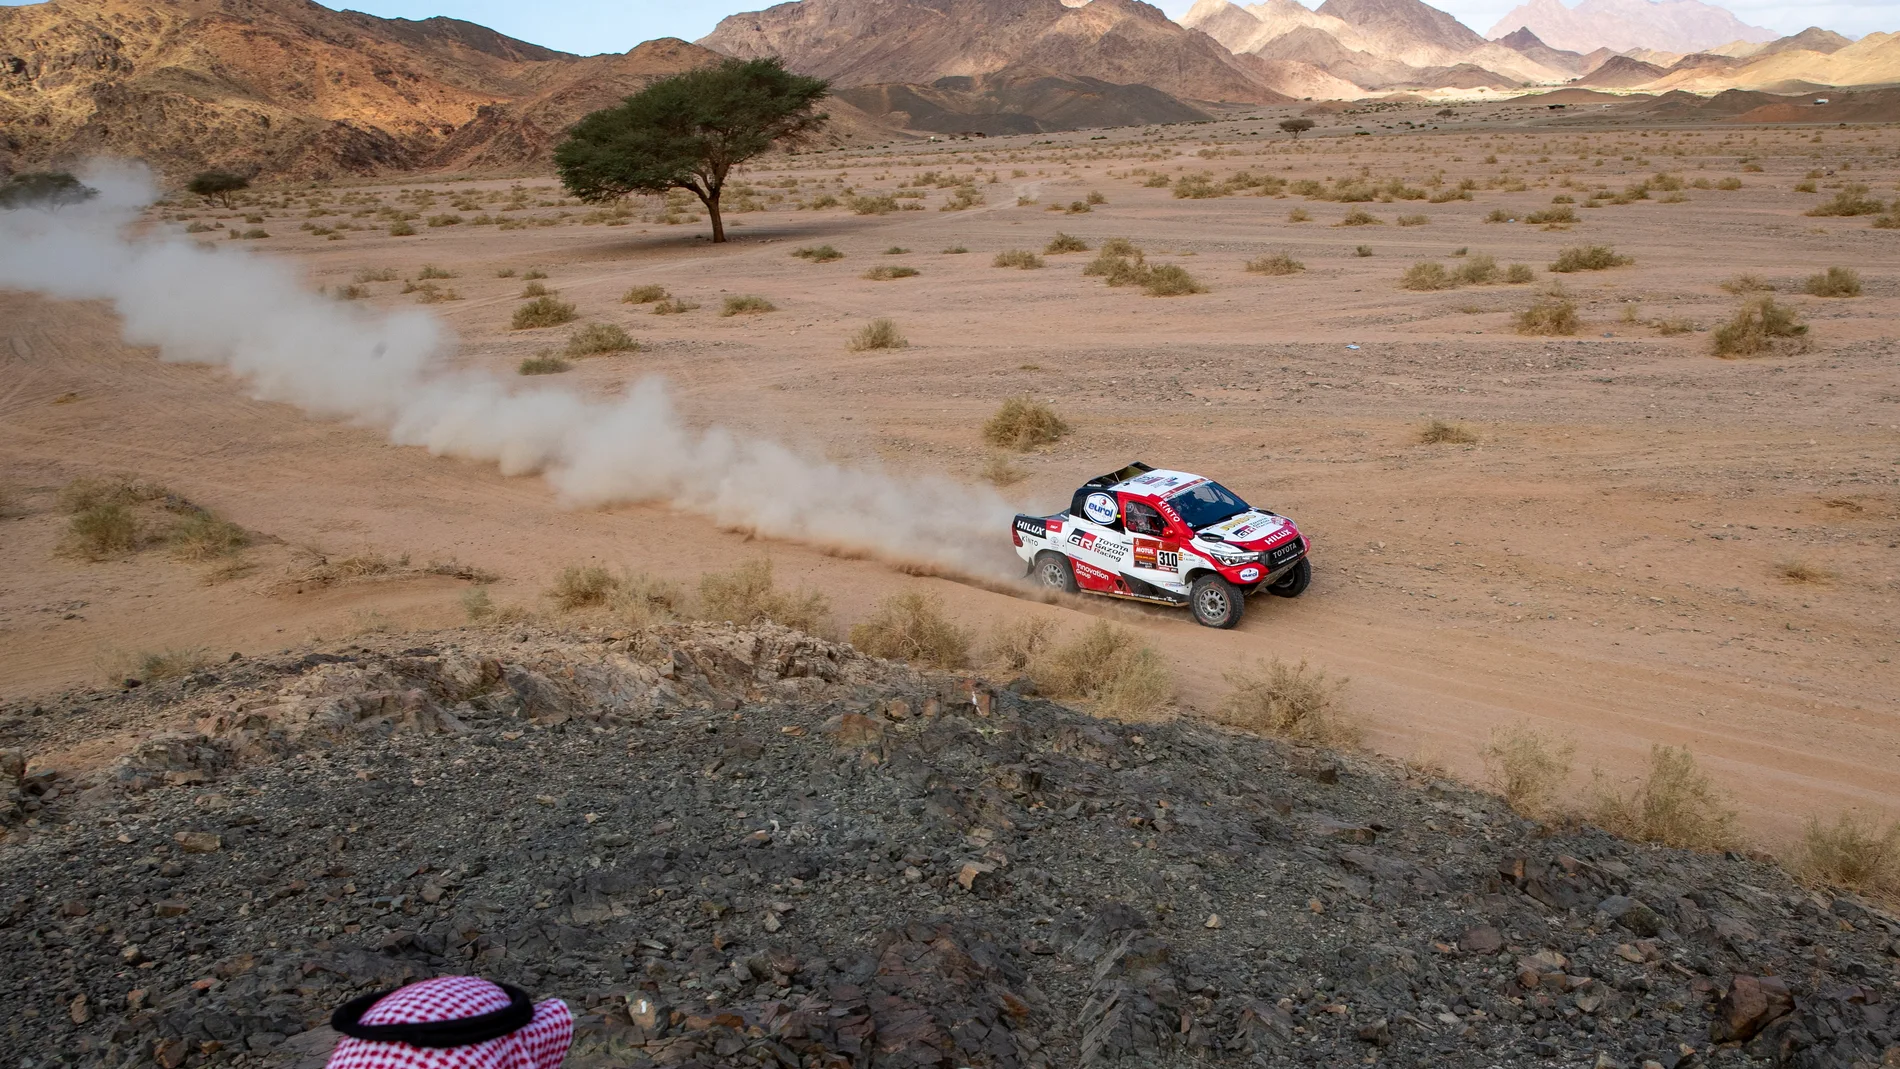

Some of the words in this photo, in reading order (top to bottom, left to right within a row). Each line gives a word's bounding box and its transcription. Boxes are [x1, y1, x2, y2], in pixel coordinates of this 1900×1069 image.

[1088, 502, 1113, 517] eurol
[1158, 500, 1180, 522] KINTO
[1016, 520, 1045, 536] HILUX
[1068, 533, 1092, 550] GR
[1264, 529, 1292, 545] HILUX
[1095, 543, 1124, 556] GAZOO
[1099, 538, 1128, 552] TOYOTA
[1136, 547, 1154, 555] MOTUL
[1272, 543, 1297, 559] TOYOTA
[1094, 548, 1121, 562] Racing
[1159, 552, 1178, 567] 310
[1076, 561, 1109, 580] Innovation
[1076, 569, 1091, 578] Group
